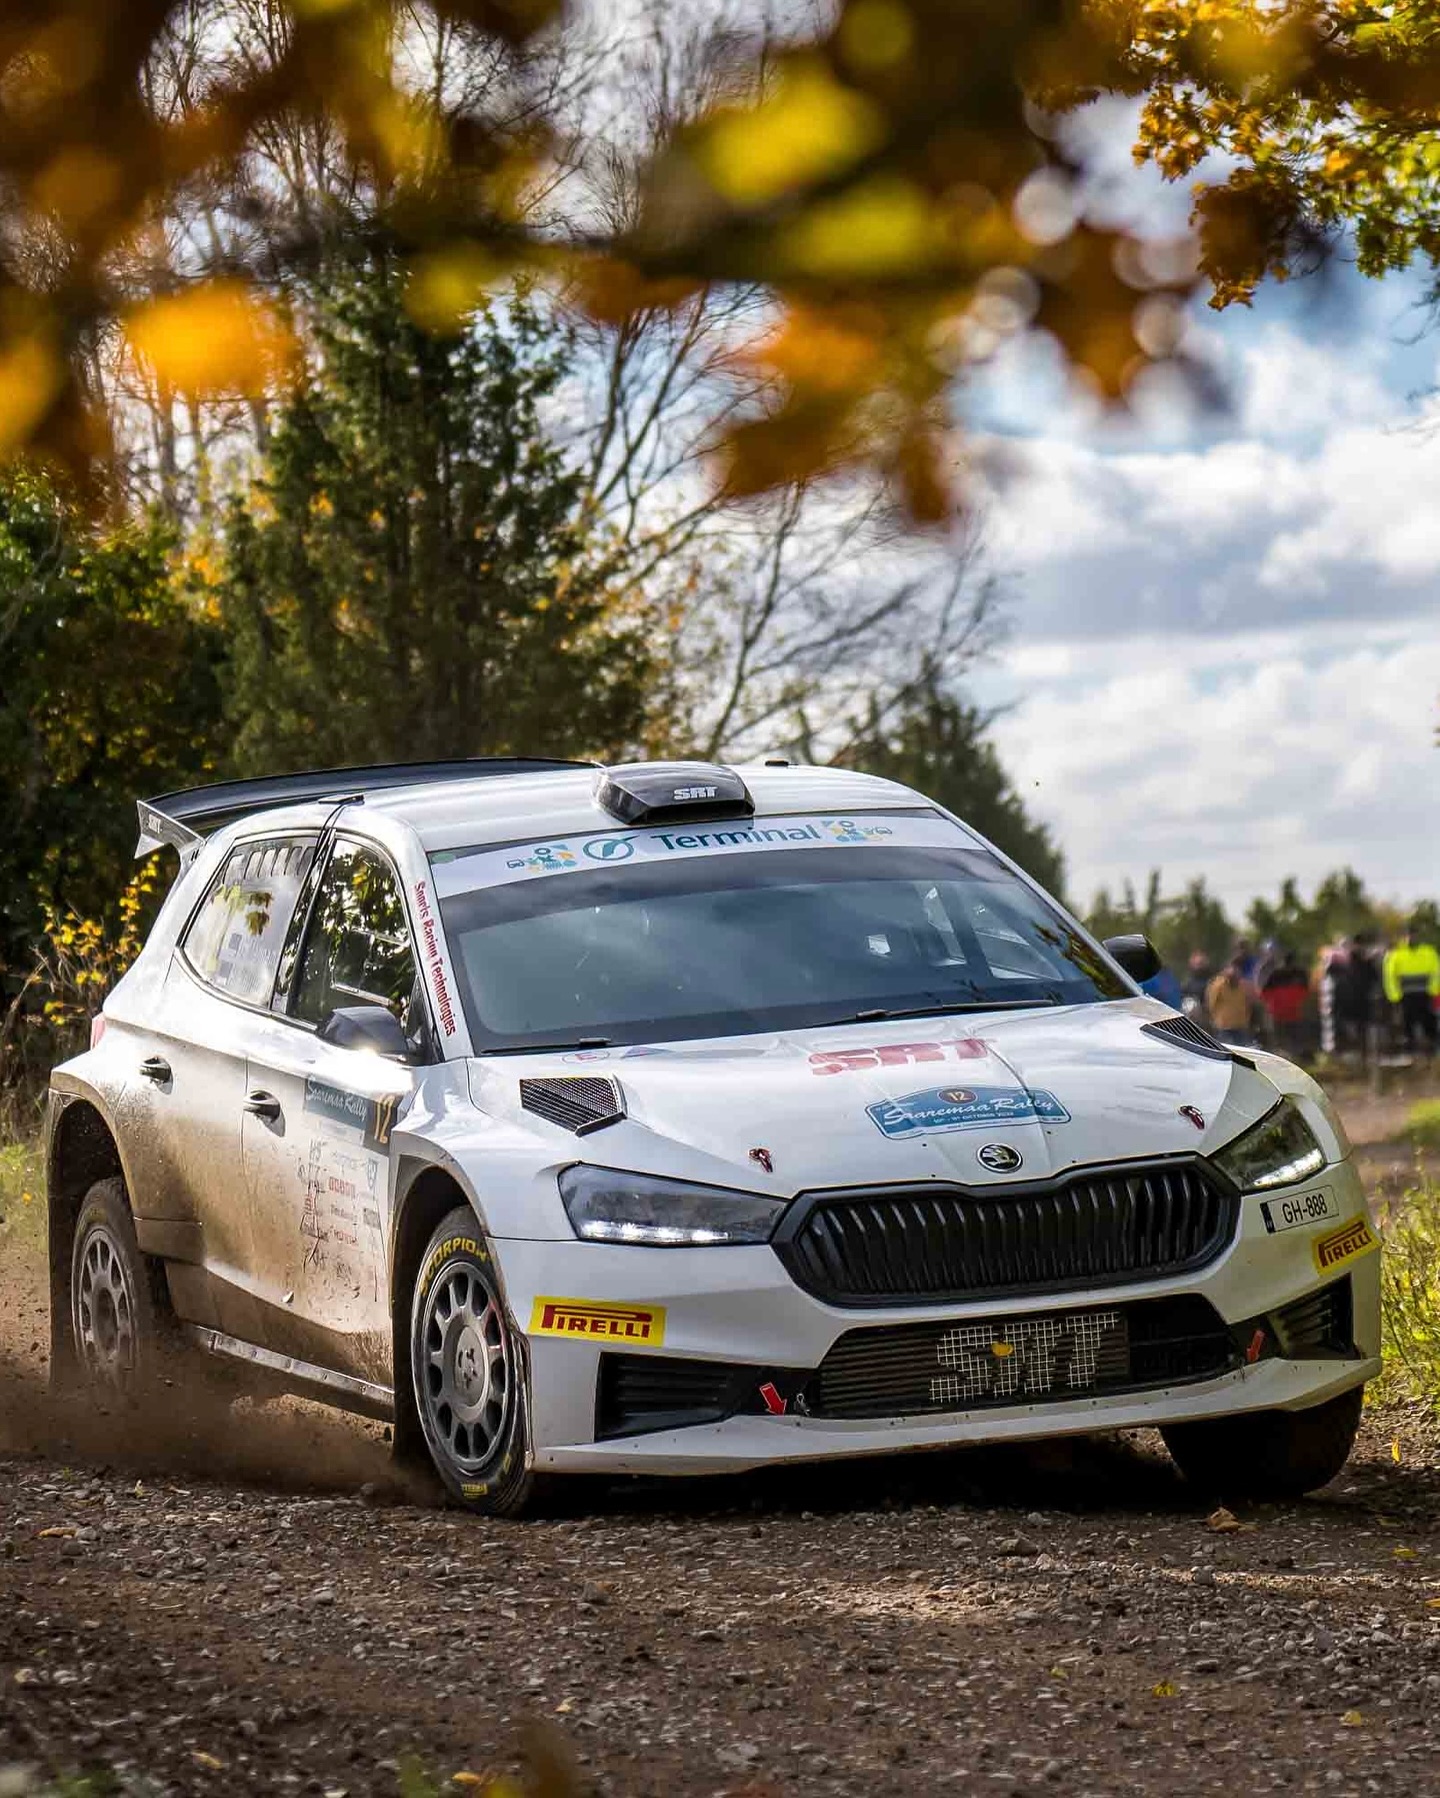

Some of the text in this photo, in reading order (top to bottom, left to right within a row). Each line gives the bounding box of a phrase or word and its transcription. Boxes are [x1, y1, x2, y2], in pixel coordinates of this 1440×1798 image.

[673, 786, 719, 800] SRT
[650, 824, 821, 851] Terminal
[431, 956, 457, 1037] Technologies
[883, 1102, 991, 1126] Saaremaa
[989, 1096, 1055, 1116] Rally
[946, 1090, 971, 1103] 12
[373, 1094, 396, 1144] 12
[1281, 1193, 1328, 1224] GH-888
[1317, 1220, 1373, 1268] PIRELLI
[540, 1304, 653, 1339] PIRELLI
[929, 1311, 1121, 1404] SRT
